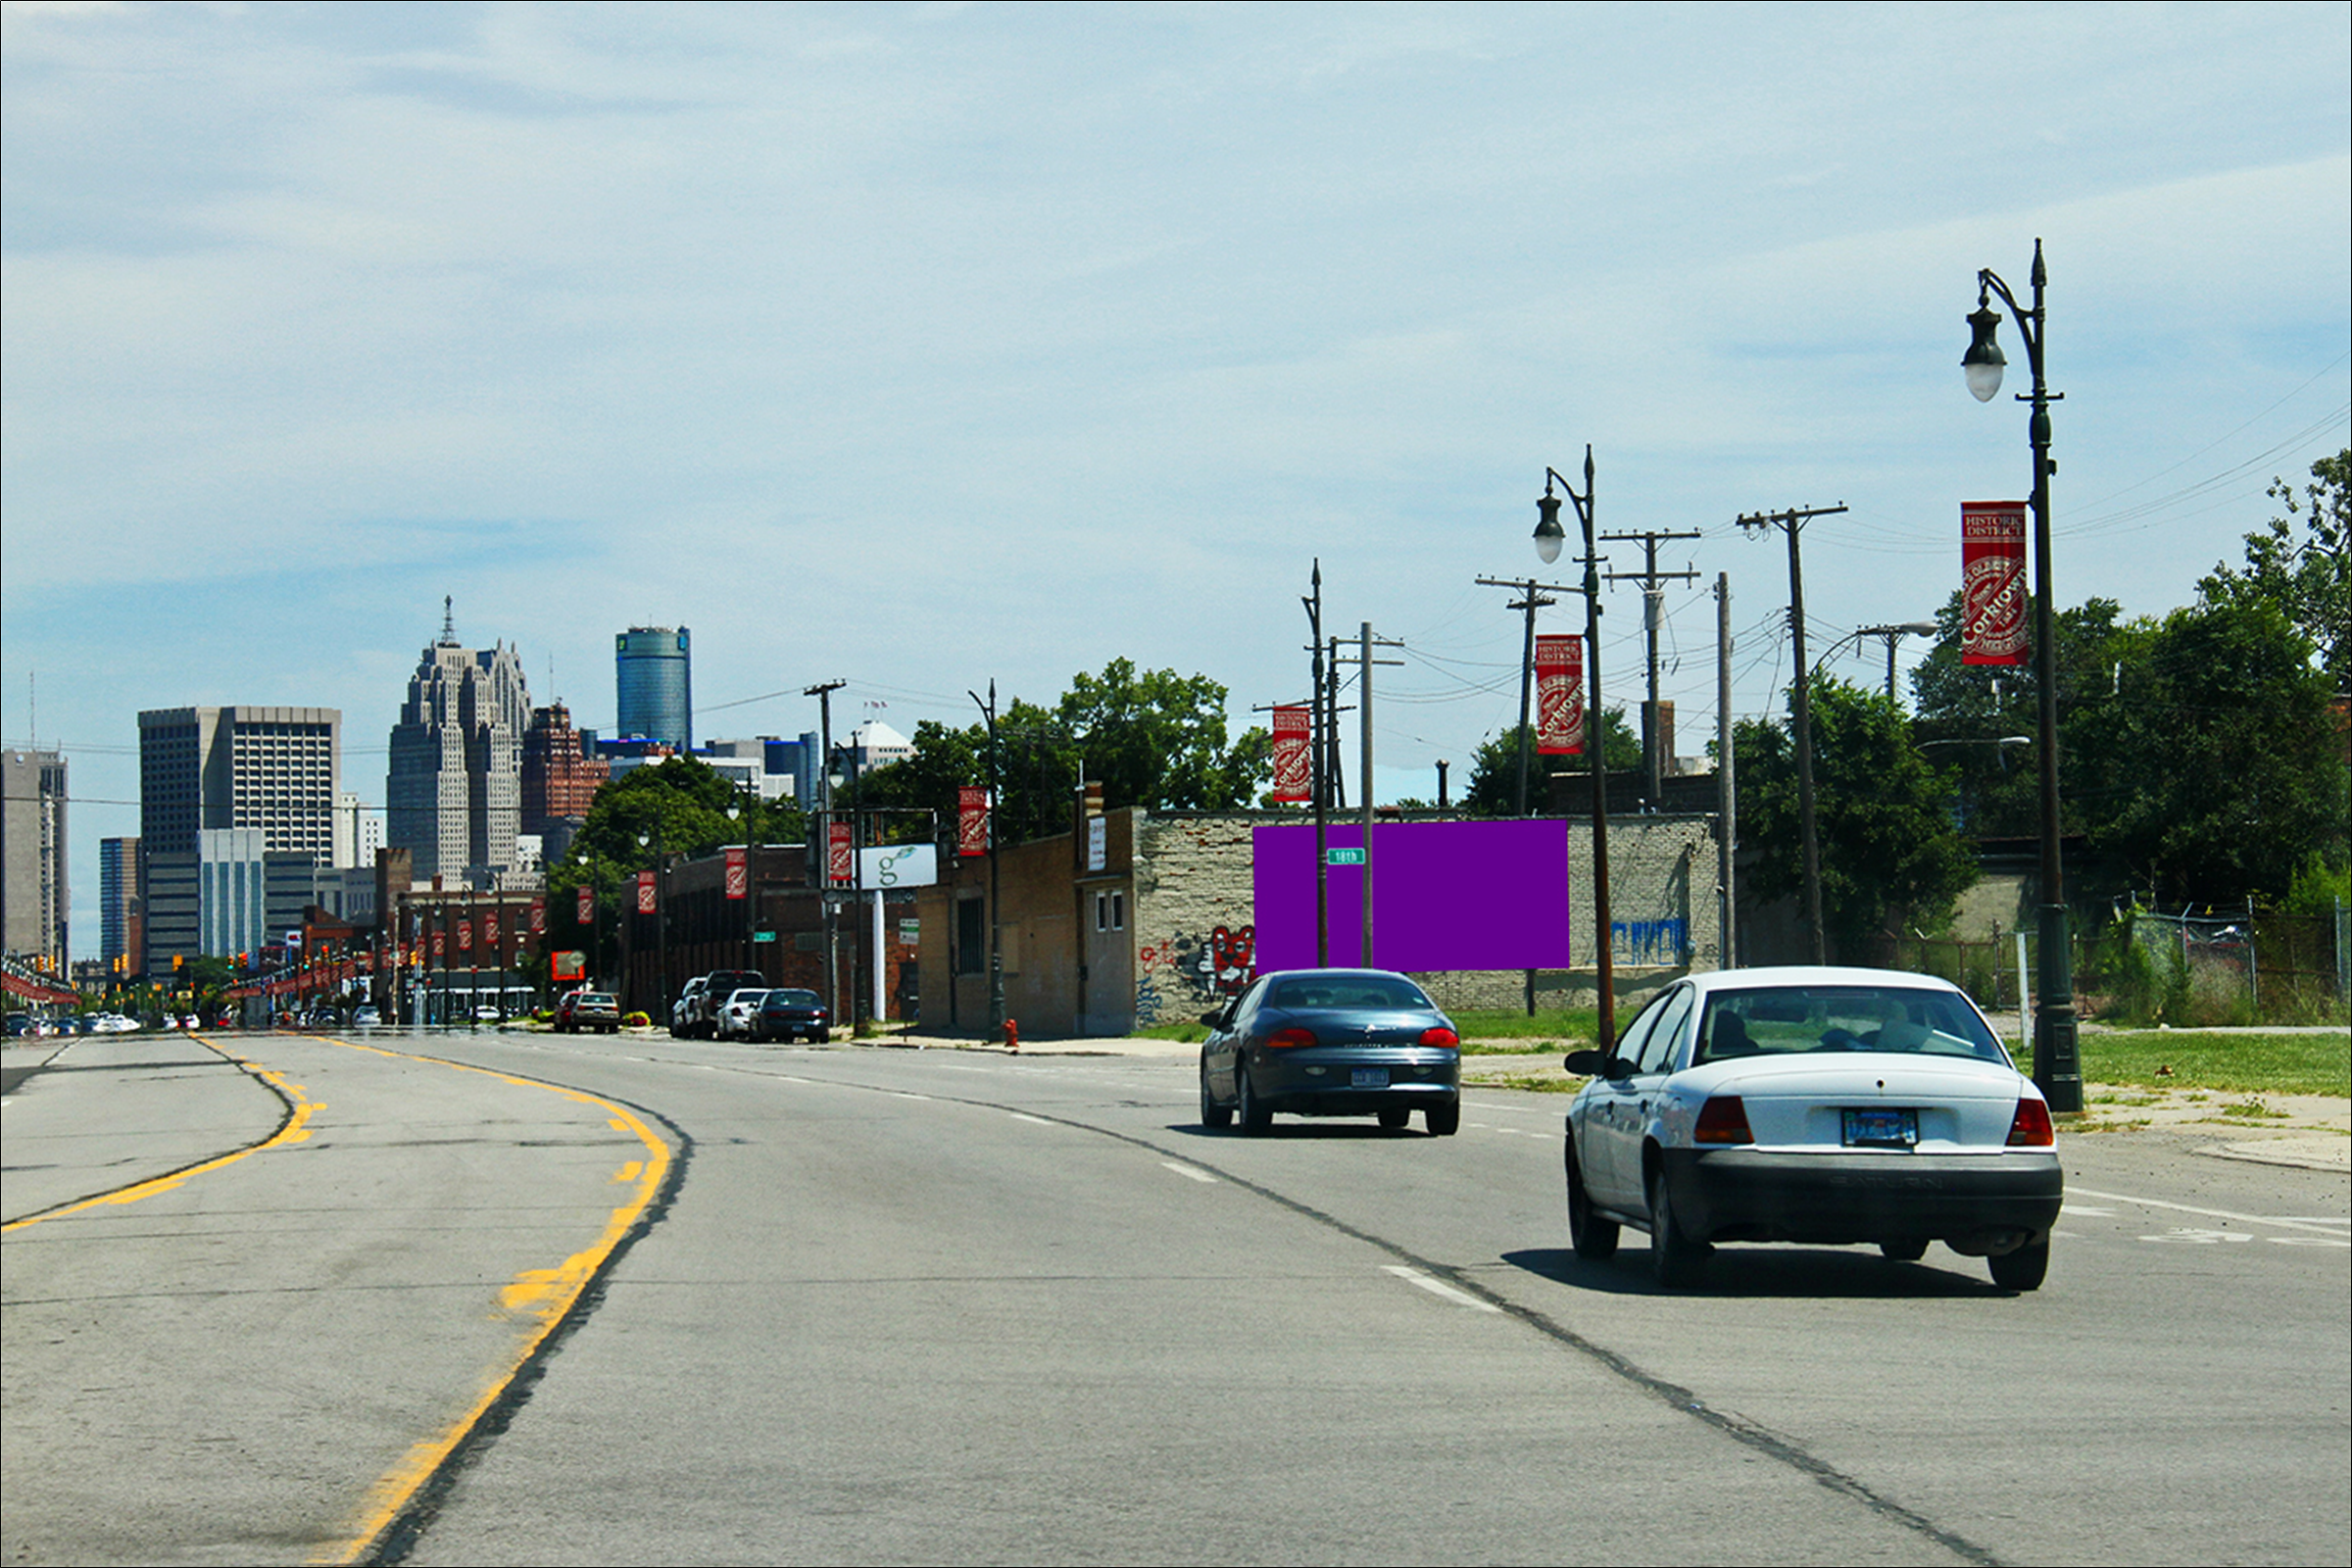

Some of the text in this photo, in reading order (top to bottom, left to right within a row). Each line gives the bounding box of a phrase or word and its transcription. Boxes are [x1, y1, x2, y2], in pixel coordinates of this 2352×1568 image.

[1966, 515, 2023, 526] HISTORIC
[1967, 525, 2023, 536] DISTRICT
[1962, 567, 2027, 645] Corktown
[1536, 683, 1583, 740] Corktown
[1336, 851, 1357, 862] 18th
[1828, 1176, 1942, 1189] SATURN
